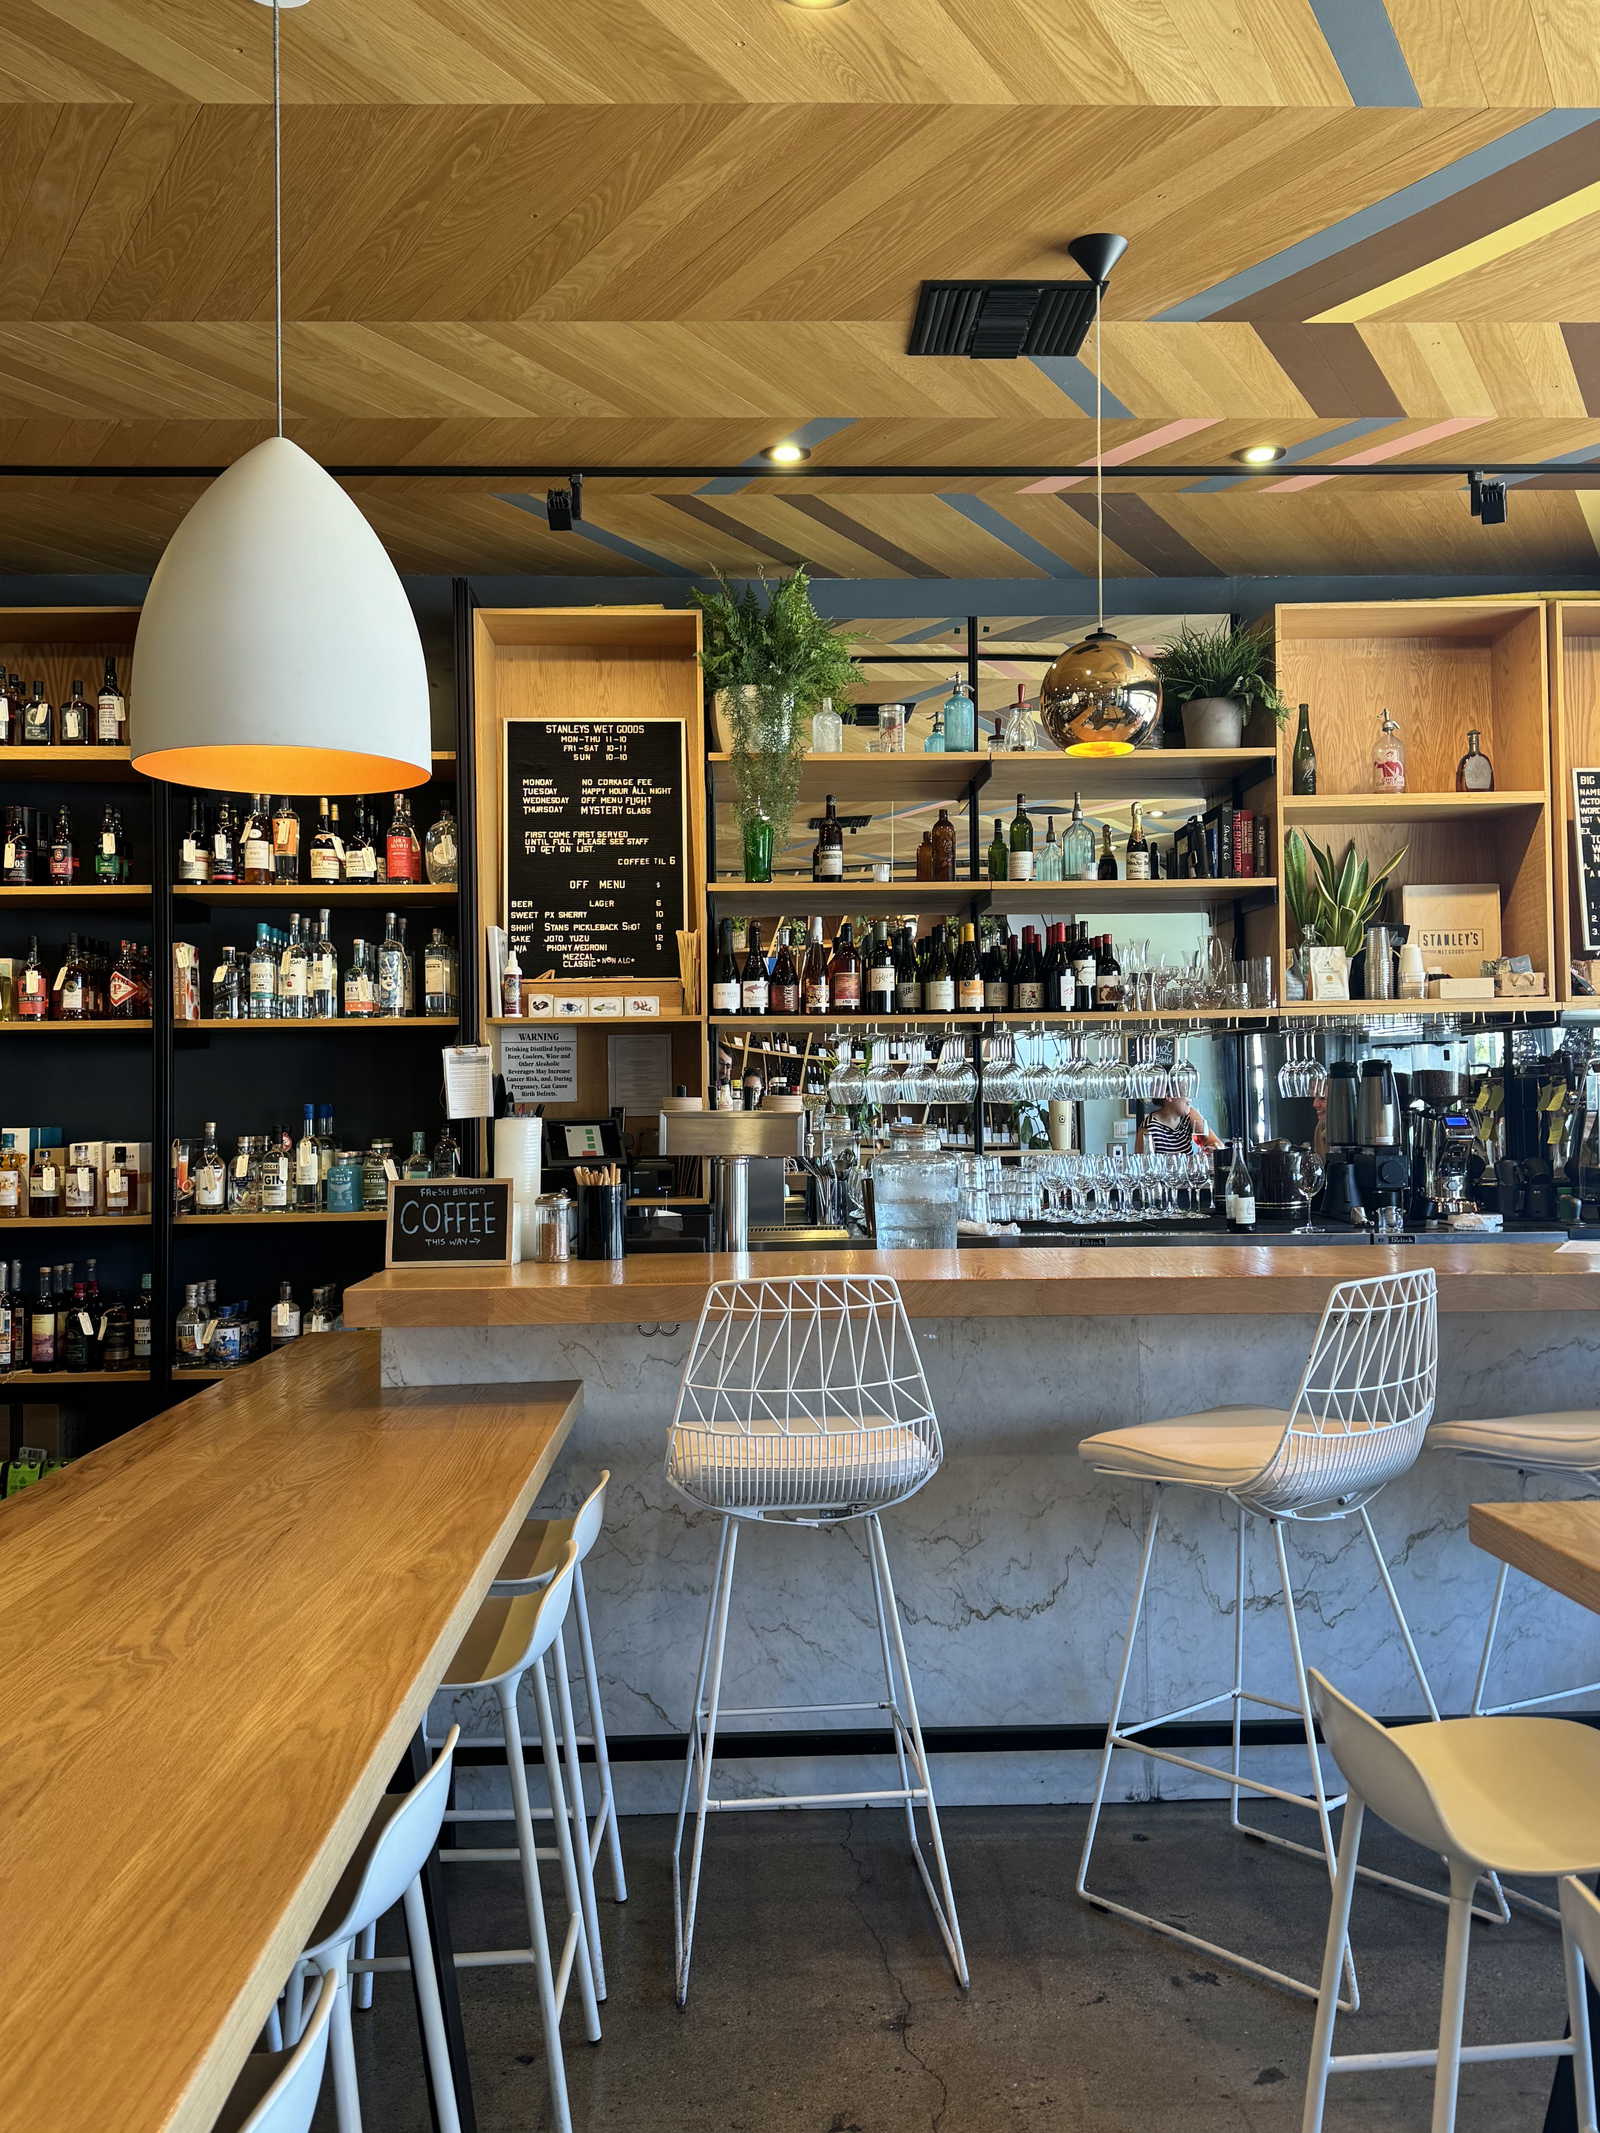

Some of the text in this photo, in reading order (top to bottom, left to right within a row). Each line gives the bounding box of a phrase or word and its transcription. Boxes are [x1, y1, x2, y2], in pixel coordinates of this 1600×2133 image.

[546, 725, 645, 734] STANLEYS WET GOODS
[1580, 776, 1596, 785] BIG
[523, 786, 672, 797] TUESDAY HAPPY HOUR ALL NIGHT
[523, 806, 564, 815] THURSDAY
[580, 806, 623, 815] MYSTERY
[525, 831, 629, 839] FIRST COME FIRST SERVED
[525, 846, 536, 855] TO
[540, 846, 556, 855] GET
[617, 856, 676, 866] COFFEE TIL 6
[569, 880, 589, 890] OFF
[599, 880, 626, 890] MENU
[511, 900, 533, 908] BEER
[589, 900, 615, 908] LAGER
[656, 910, 664, 918] 10
[511, 934, 664, 943] SAKE JOTO YUZU 12
[1423, 932, 1479, 946] STANLEY'S
[514, 945, 528, 954] N/A
[546, 944, 572, 952] PHONY
[562, 960, 597, 968] CLASSIC
[519, 1033, 560, 1041] WARNING
[400, 1200, 496, 1235] COFFEE
[425, 1238, 468, 1247] THIS WAY
